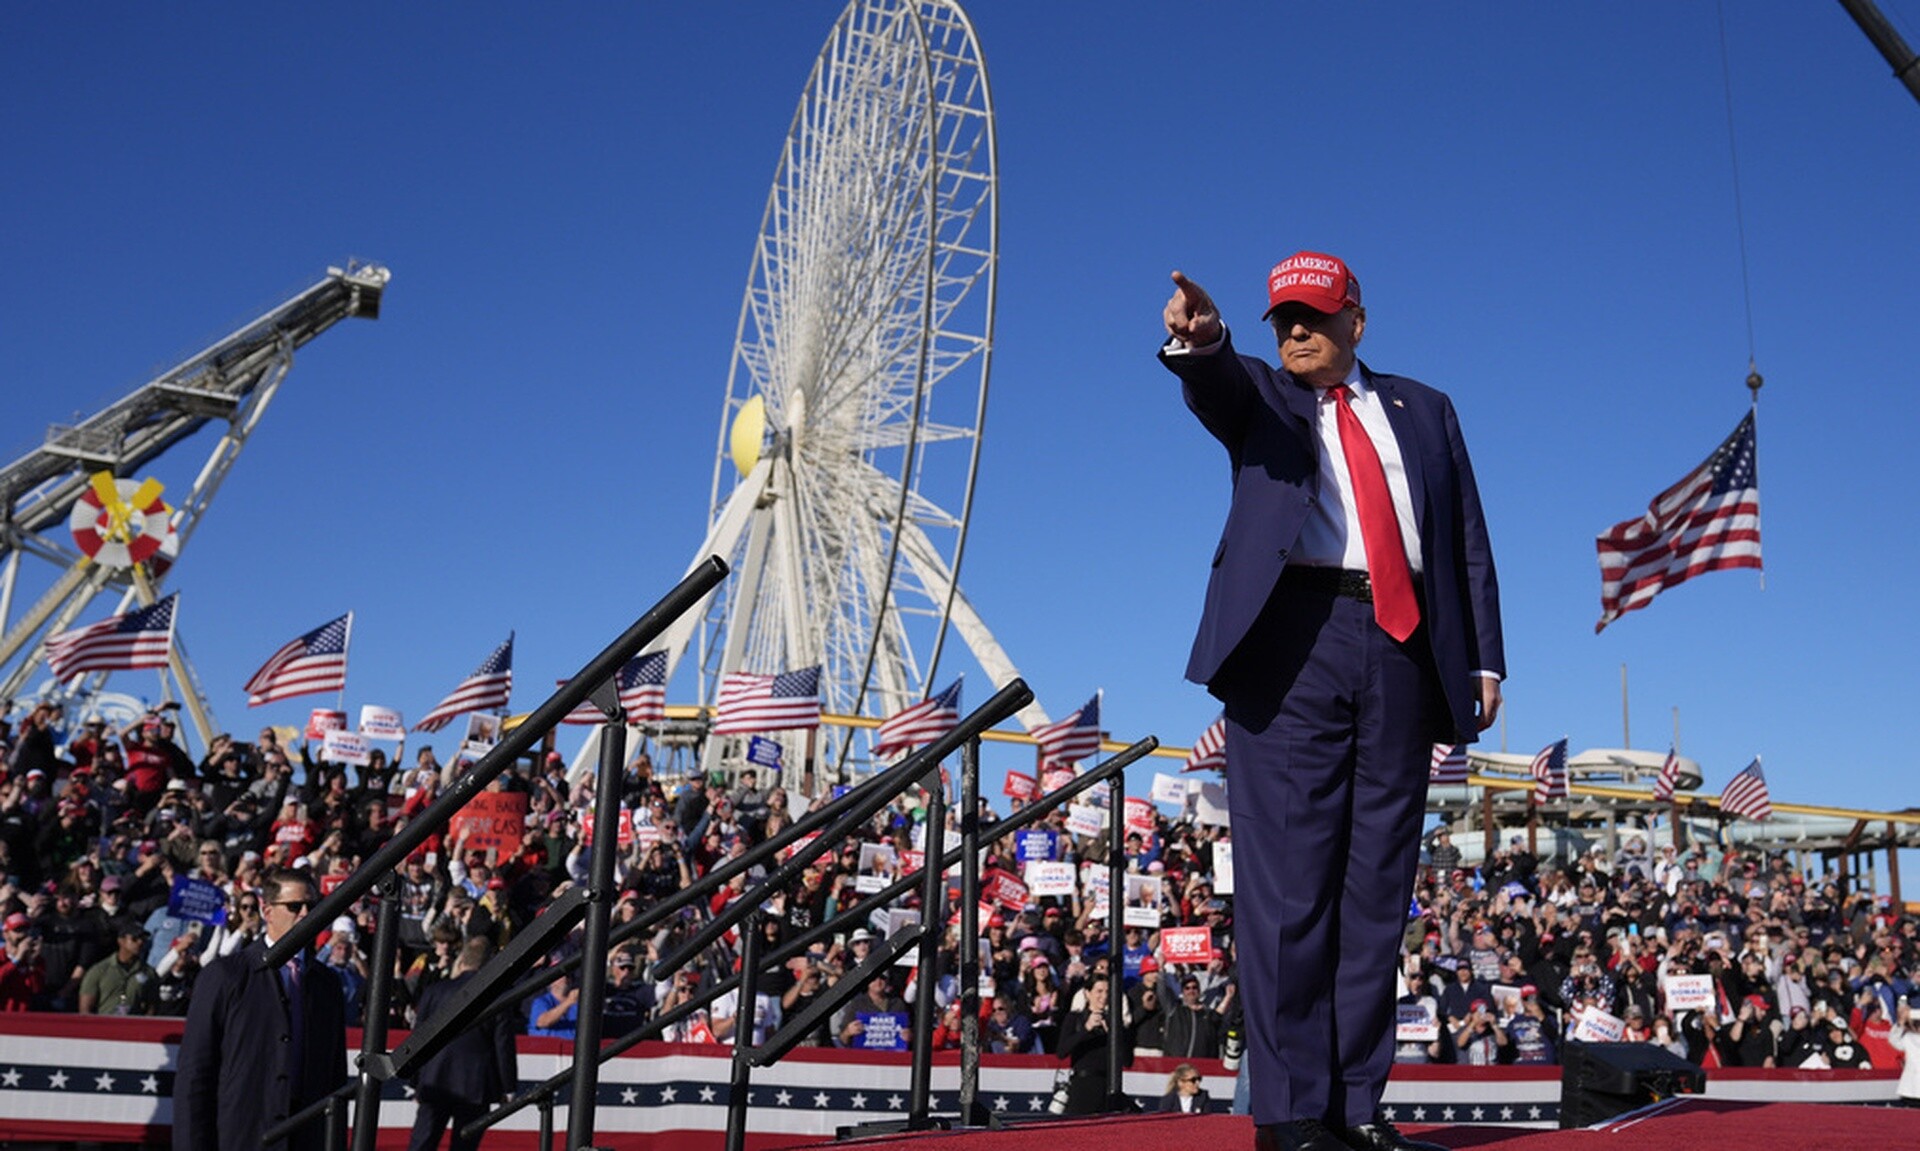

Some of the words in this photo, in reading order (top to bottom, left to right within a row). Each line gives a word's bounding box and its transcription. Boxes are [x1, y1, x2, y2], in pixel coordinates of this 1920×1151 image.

[1294, 257, 1339, 274] AMERICA
[1300, 273, 1334, 289] AGAIN
[1165, 933, 1206, 945] TRUMP
[1171, 943, 1201, 953] 2024
[1671, 988, 1708, 996] DONALD
[1675, 995, 1706, 1003] TRUMP
[869, 1016, 896, 1024] MAKE
[1596, 1016, 1618, 1031] VOTE
[863, 1023, 903, 1032] AMERICA
[1585, 1020, 1619, 1040] DONALD
[865, 1031, 897, 1039] GREAT
